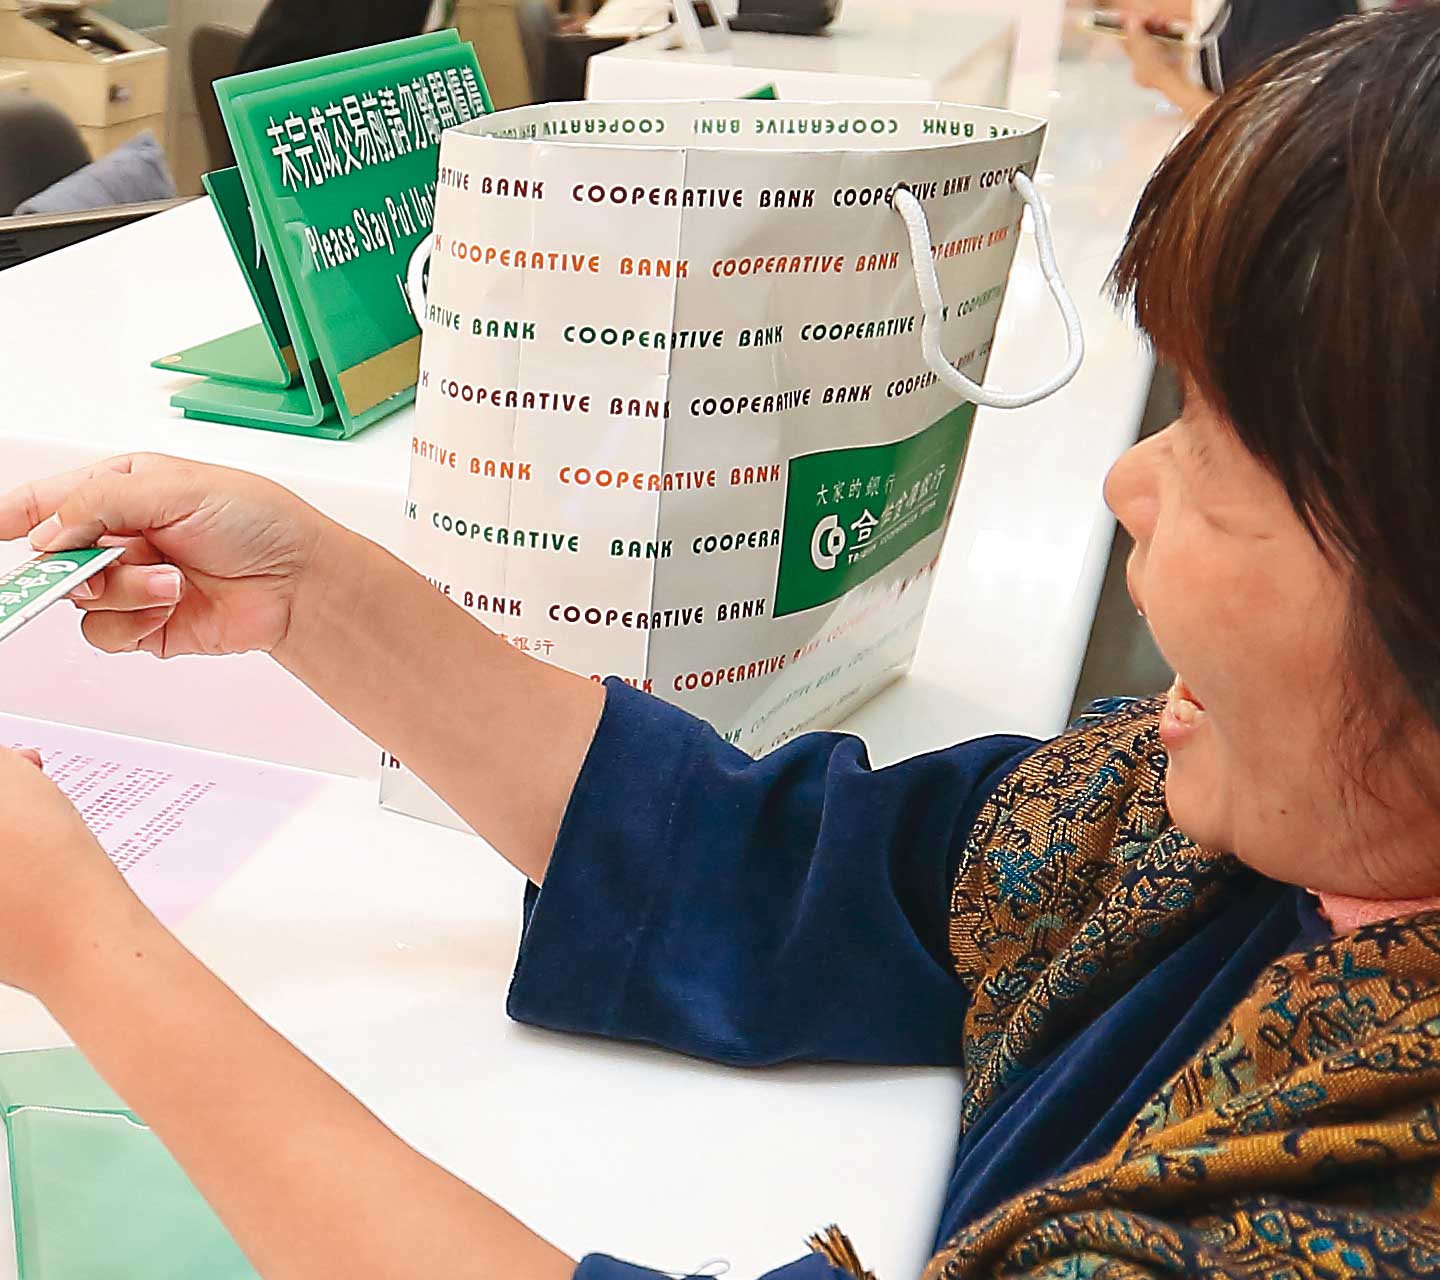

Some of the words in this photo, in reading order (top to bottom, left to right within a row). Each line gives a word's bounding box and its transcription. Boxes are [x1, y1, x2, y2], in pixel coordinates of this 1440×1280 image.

[694, 119, 740, 134] BAN
[755, 119, 898, 135] COOPERATIVE
[481, 176, 544, 199] BANK
[572, 184, 742, 207] COOPERATIVE
[759, 189, 815, 208] BANK
[833, 180, 937, 208] COOPETIVE
[304, 225, 360, 272] Please
[353, 207, 395, 255] Stay
[385, 191, 417, 238] Put
[409, 181, 436, 228] Unt
[451, 240, 600, 273] COOPERATIVE
[620, 257, 689, 278] BANK
[712, 255, 844, 278] COOPERATIVE
[855, 251, 899, 272] BANK
[472, 318, 536, 340] BANK
[564, 325, 723, 349] COOPERATIVE
[738, 325, 783, 347] BANK
[801, 315, 915, 341] COOPERATIVE
[440, 378, 591, 413] COOPERATIVE
[690, 388, 811, 417] COOPERATIVE
[822, 384, 872, 404] BANK
[470, 457, 532, 481] BANK
[559, 466, 717, 491] COOPERATIVE
[730, 464, 780, 485] BANK
[817, 473, 896, 506] 大家的銀行
[433, 511, 580, 553] COOPERATIVE
[610, 539, 673, 559] BANK
[464, 590, 522, 617] BANK
[548, 604, 704, 629] COOPERATIVE
[718, 598, 765, 621] BANK
[674, 655, 786, 692] COOPERATIVE
